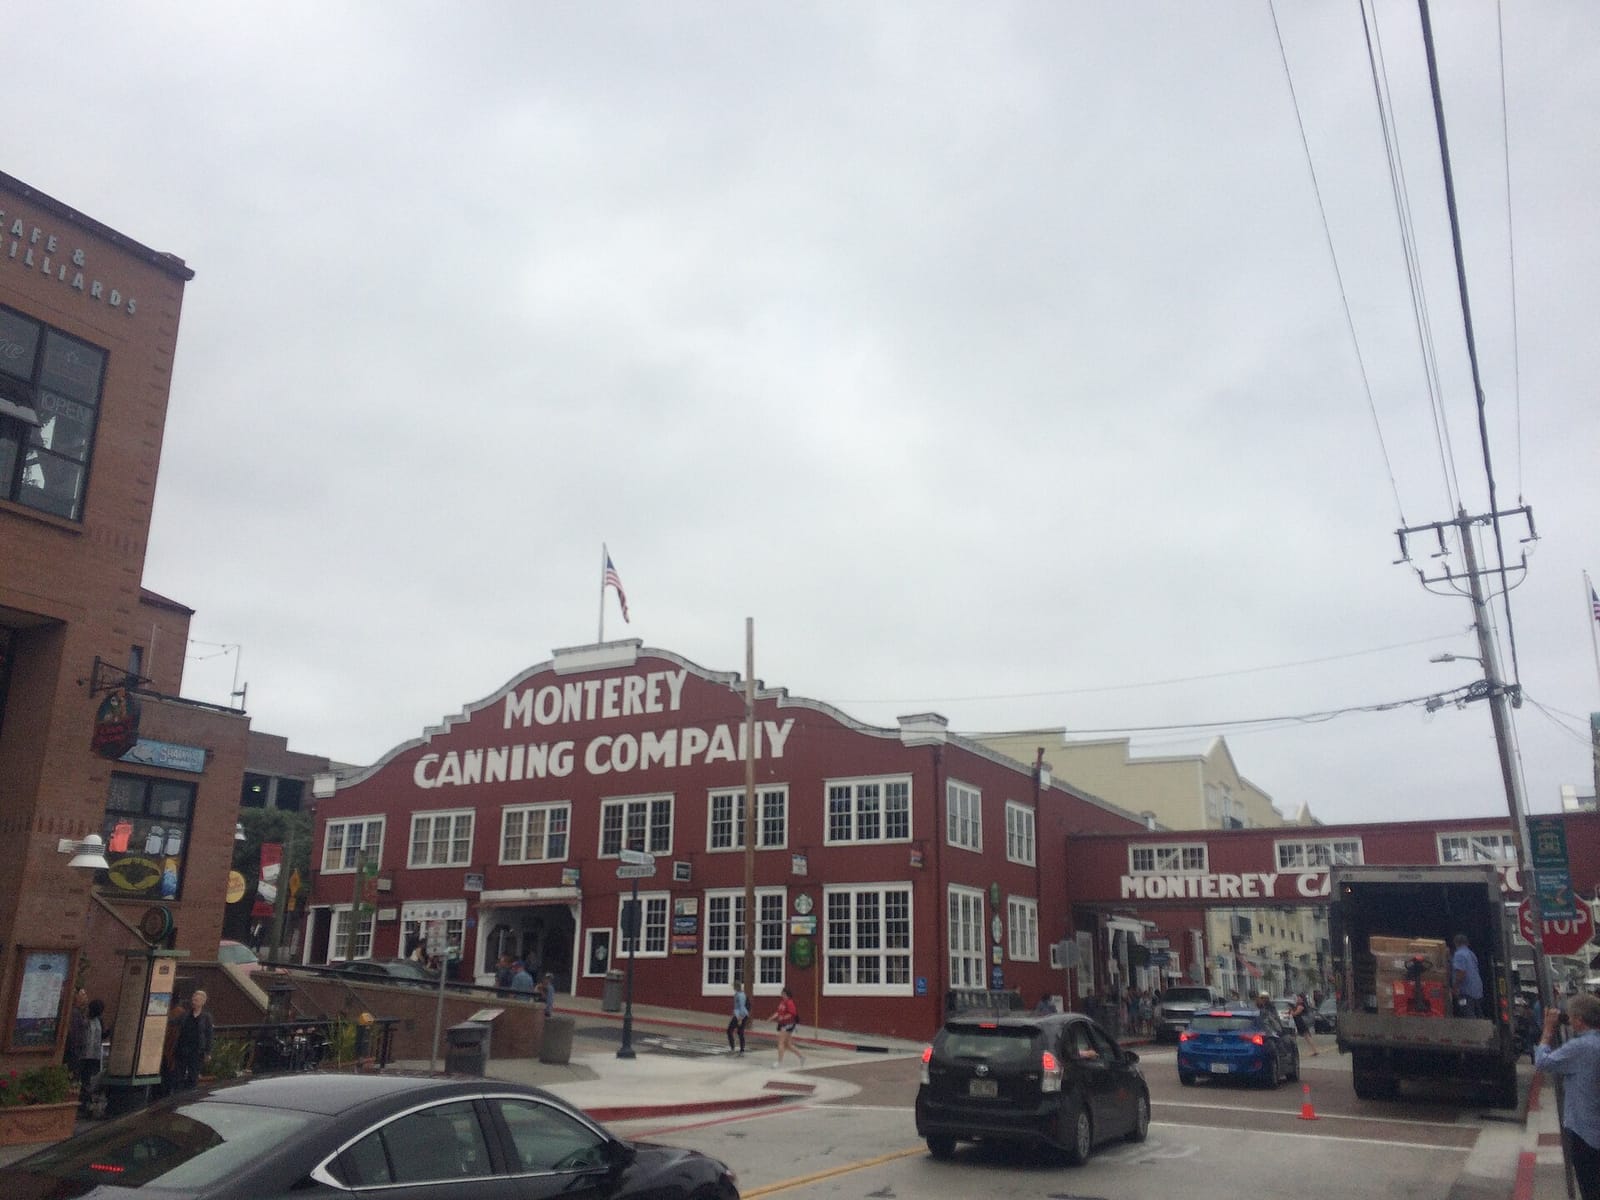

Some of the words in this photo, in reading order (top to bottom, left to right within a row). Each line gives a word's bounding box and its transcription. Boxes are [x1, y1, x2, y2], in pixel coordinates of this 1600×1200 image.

[0, 233, 136, 314] ILLIARDS
[73, 248, 85, 267] &
[503, 670, 688, 729] MONTEREY
[413, 741, 574, 789] CANNING
[585, 718, 795, 775] COMPANY
[1120, 873, 1278, 899] MONTEREY
[1523, 909, 1588, 935] STOP
